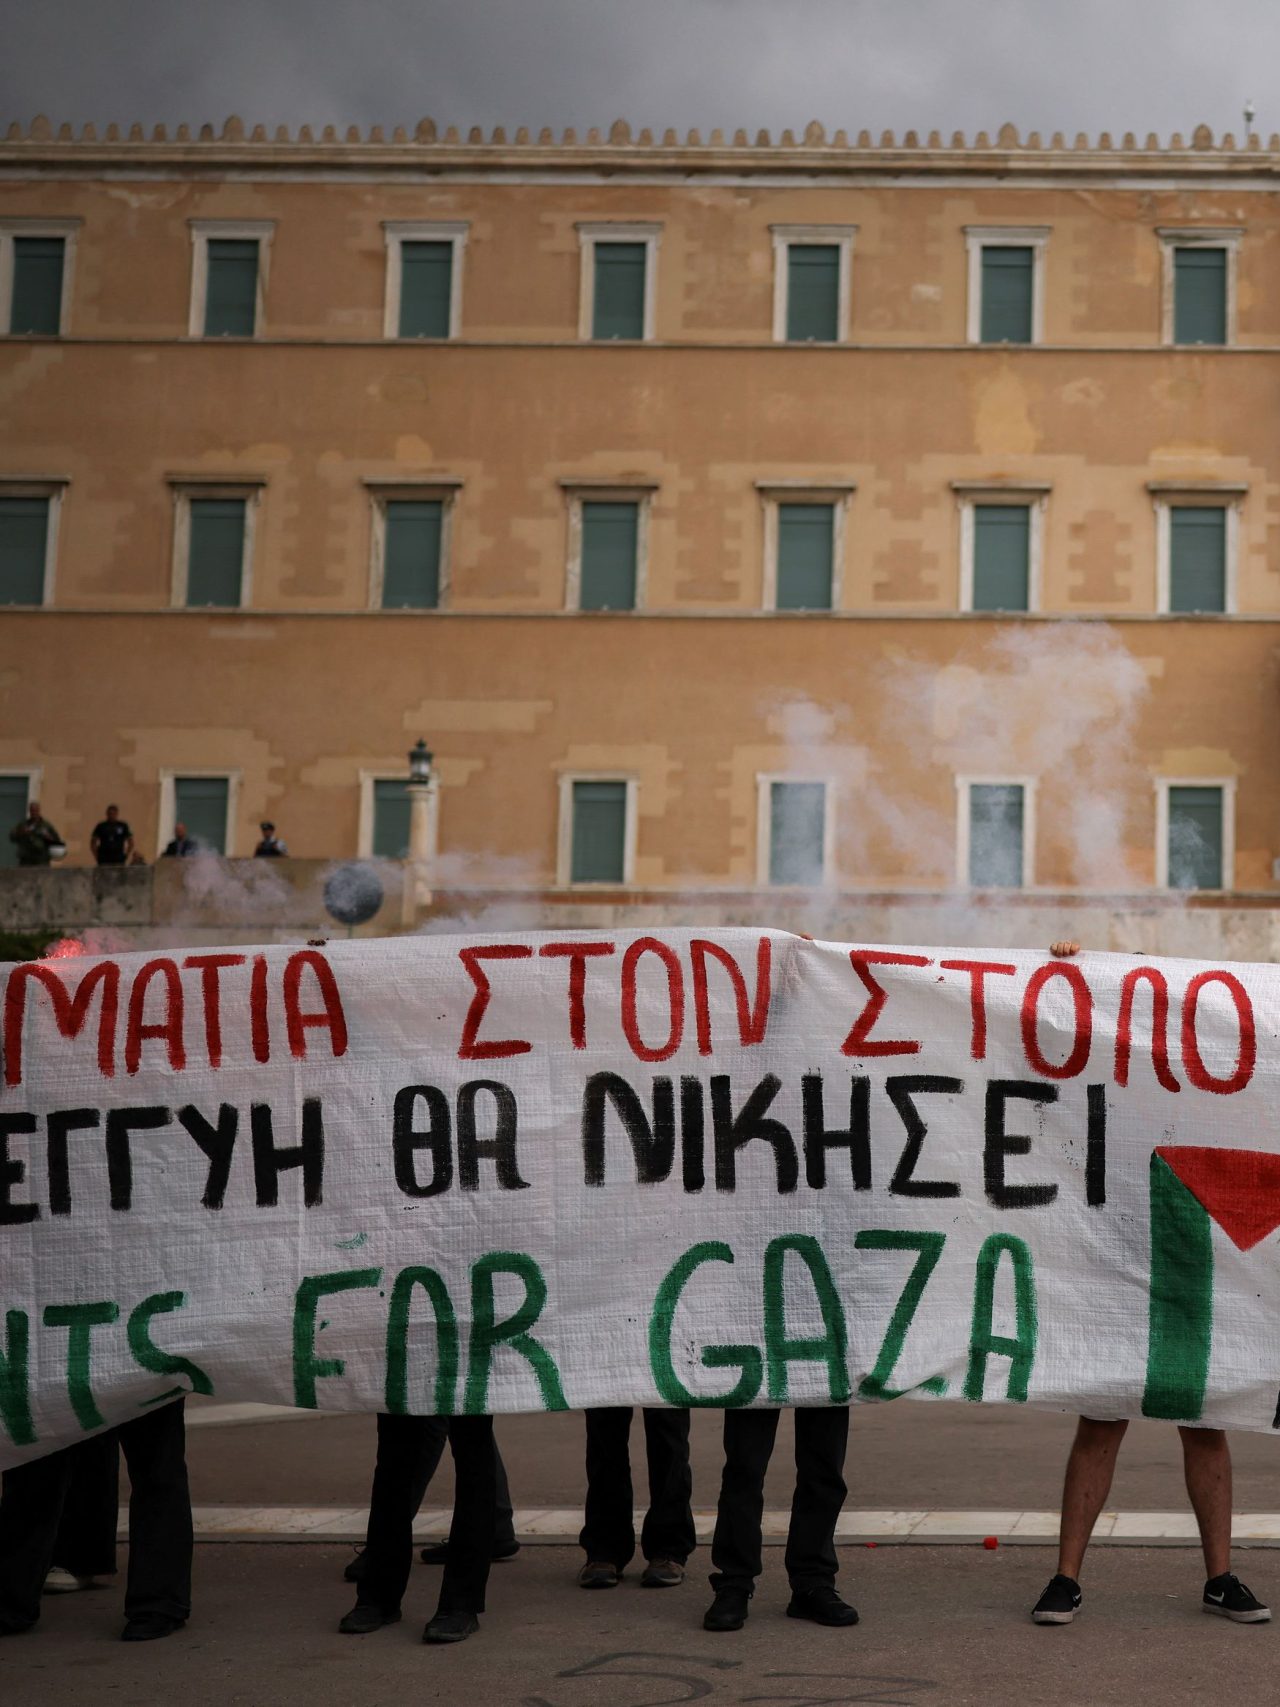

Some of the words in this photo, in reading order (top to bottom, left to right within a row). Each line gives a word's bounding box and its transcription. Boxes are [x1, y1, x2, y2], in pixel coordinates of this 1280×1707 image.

[3, 938, 348, 1087] ΜΑΤΙΑ
[457, 936, 772, 1063] ΣΤΟΝ
[840, 944, 1257, 1095] ΣΤΟΛΟ
[0, 1096, 326, 1227] ΕΓΓΥΗ
[391, 1079, 532, 1199] ΘΑ
[581, 1071, 1107, 1210] ΝΙΚΗΣΕΙ
[648, 1229, 1039, 1409] GAZA
